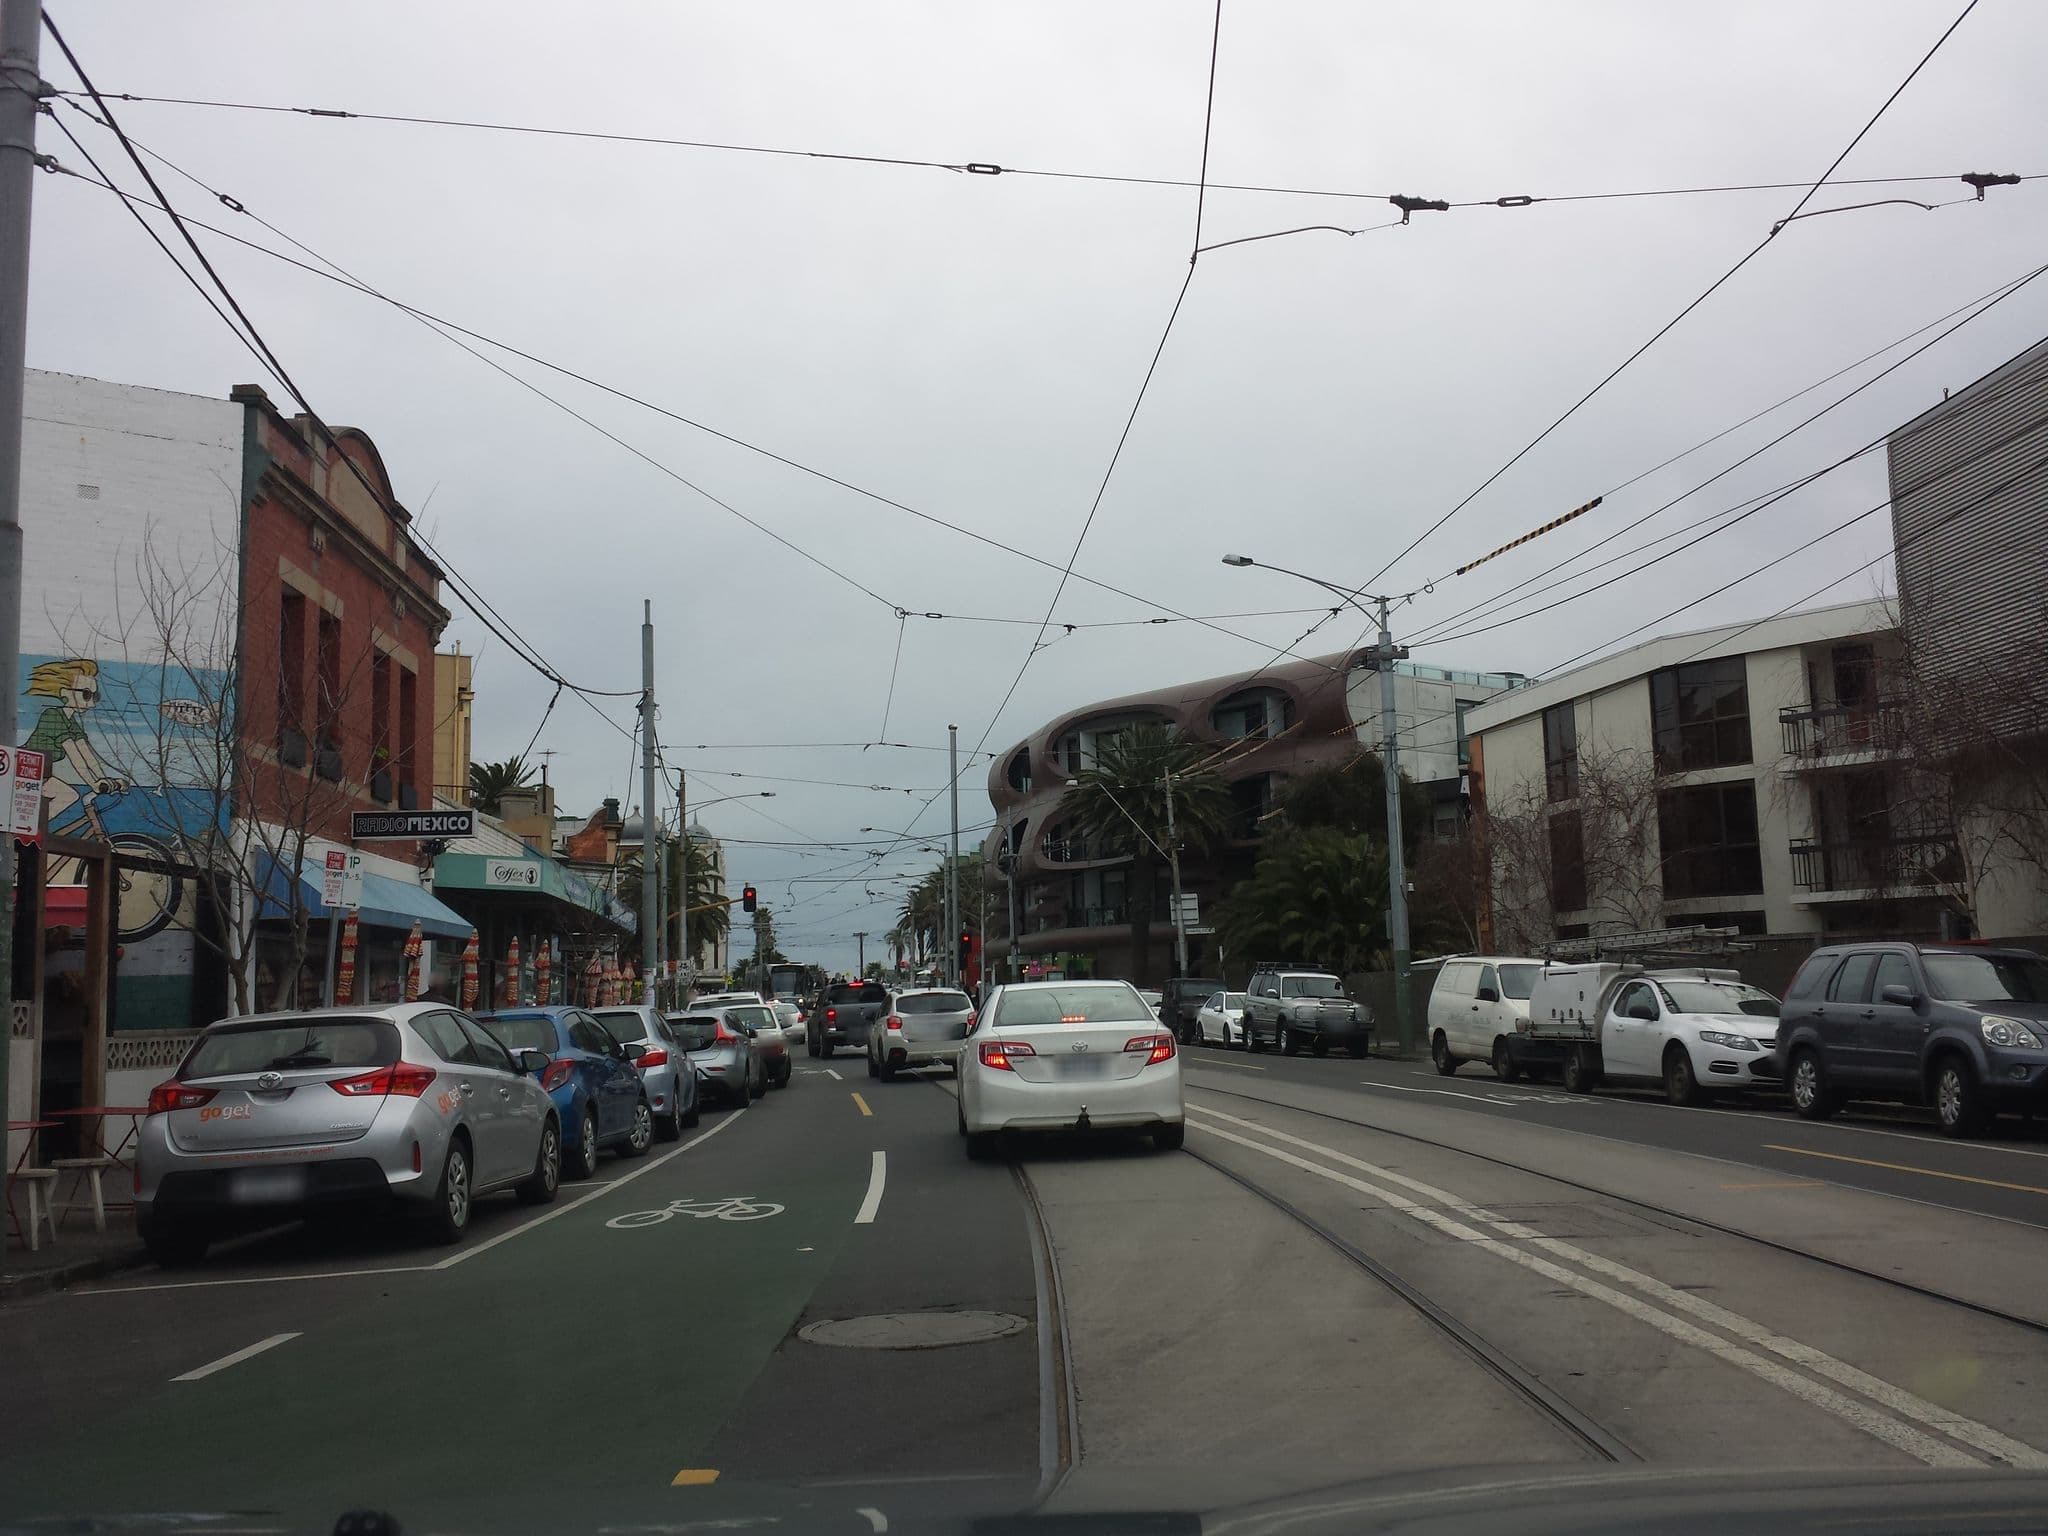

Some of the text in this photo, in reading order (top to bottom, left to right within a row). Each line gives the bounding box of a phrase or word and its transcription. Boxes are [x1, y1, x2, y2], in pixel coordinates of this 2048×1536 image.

[18, 752, 40, 768] PERMIT
[20, 765, 38, 779] ZONE
[15, 780, 40, 791] goget
[349, 855, 361, 869] 1P
[200, 1103, 252, 1122] goget
